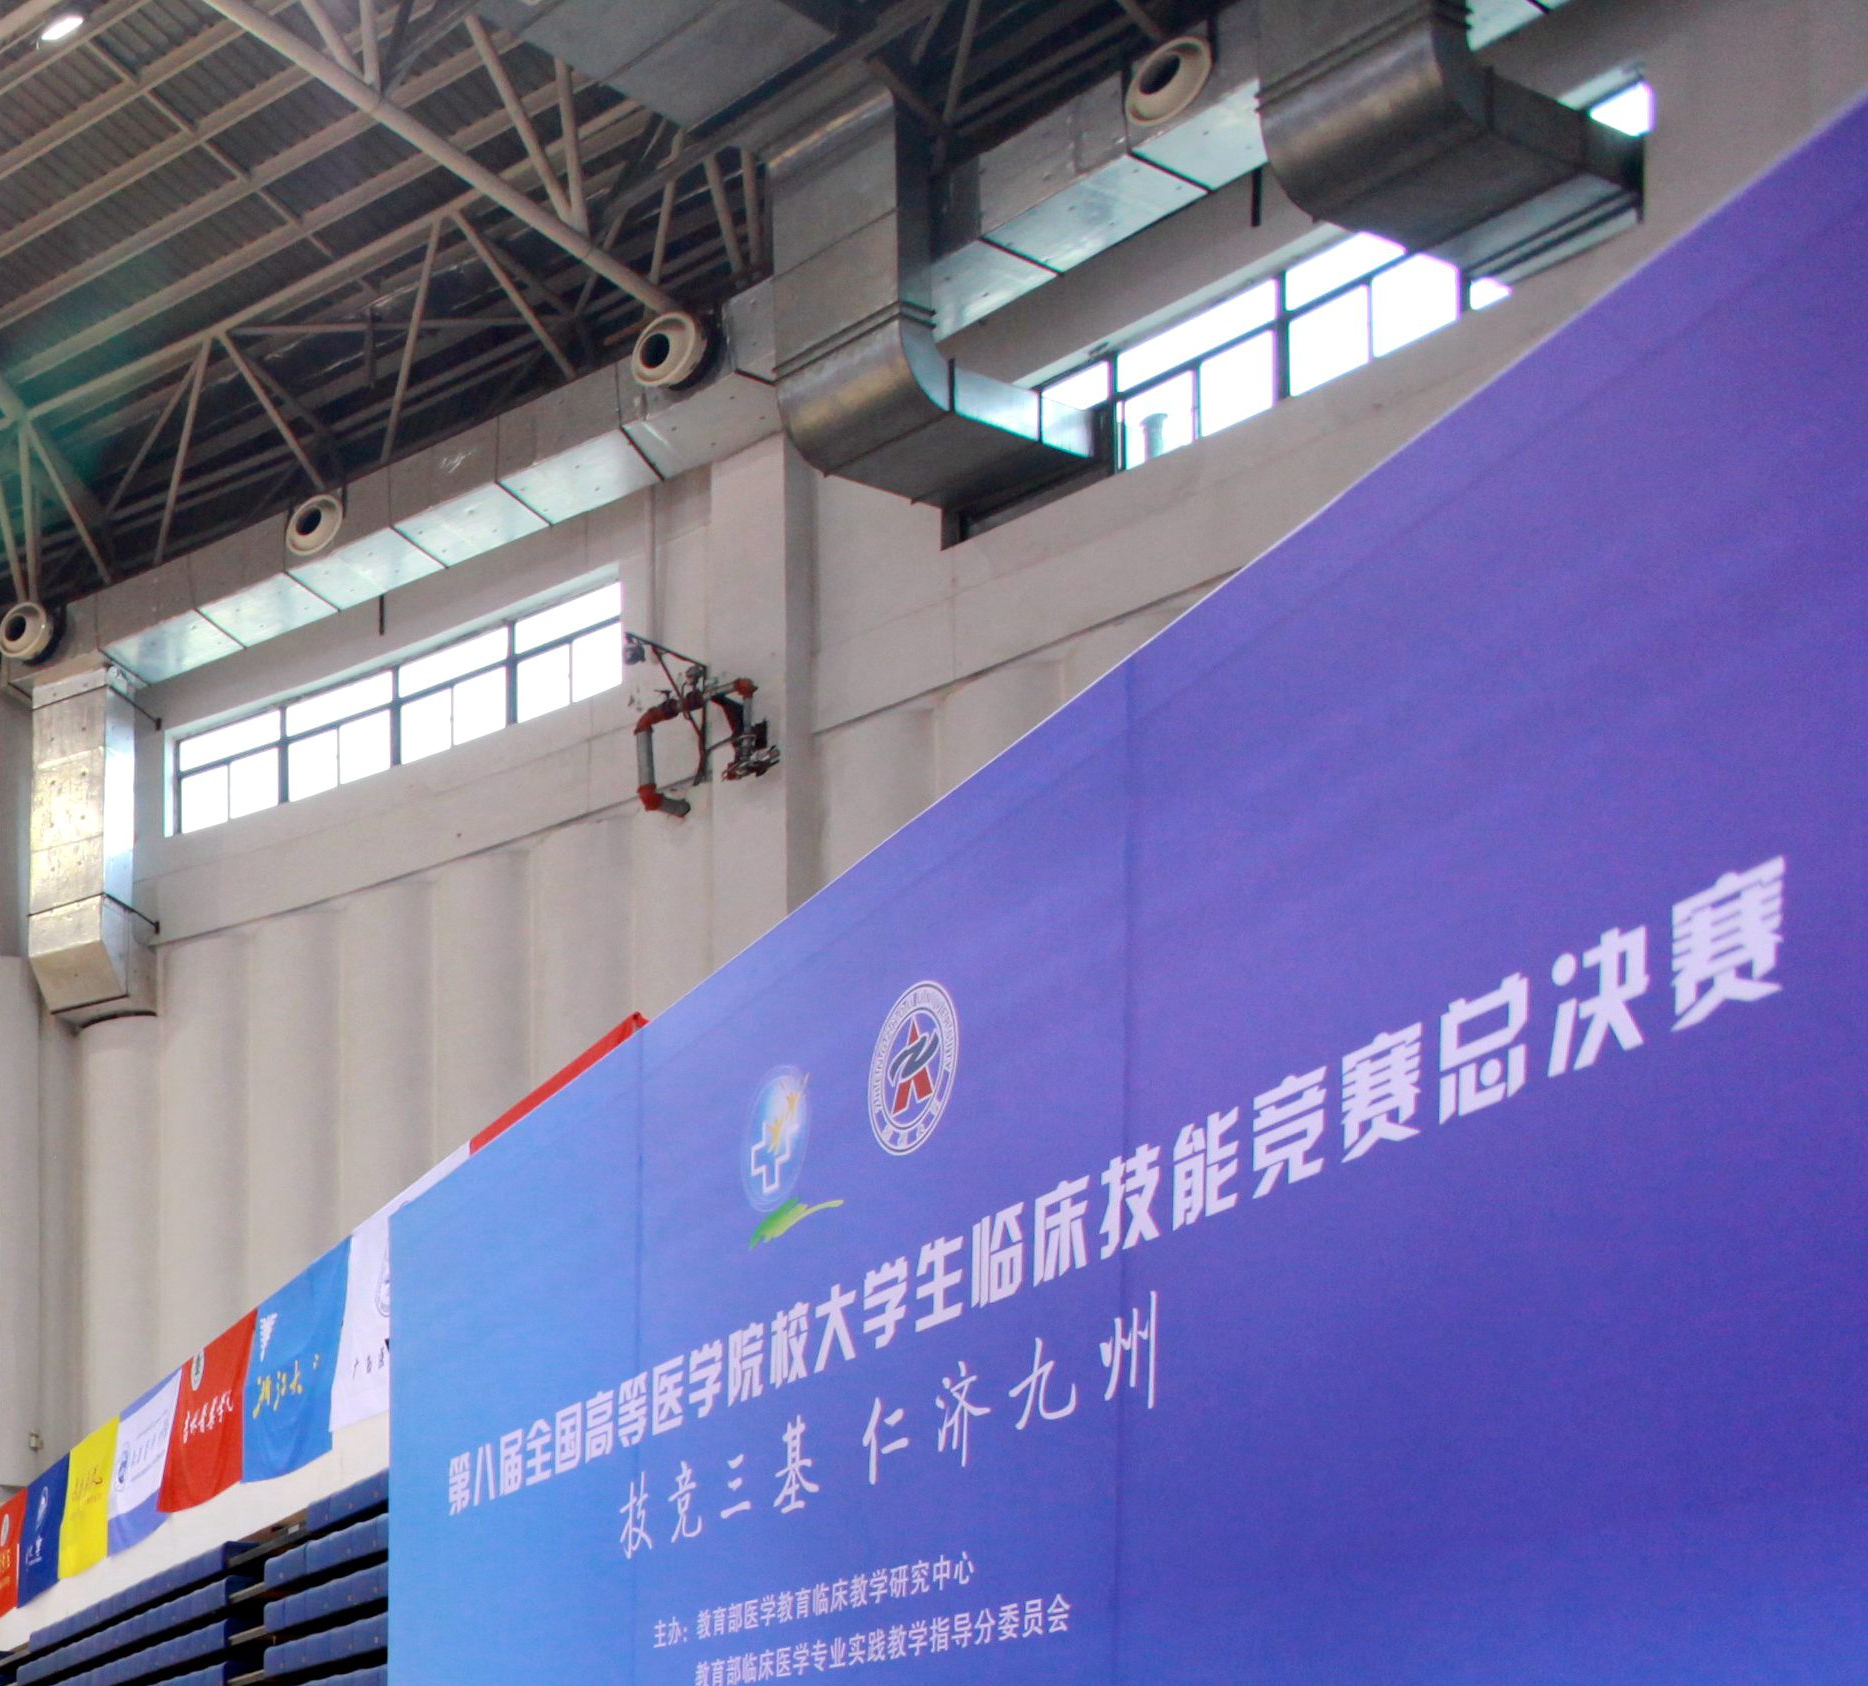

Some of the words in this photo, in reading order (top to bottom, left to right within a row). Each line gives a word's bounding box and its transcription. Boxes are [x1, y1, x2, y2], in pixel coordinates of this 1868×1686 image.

[448, 855, 1785, 1517] 第八届全国高等医学院校大学生临床技能竞赛总决赛
[619, 1414, 820, 1560] 技竞三基
[862, 1289, 1161, 1486] 仁济九州
